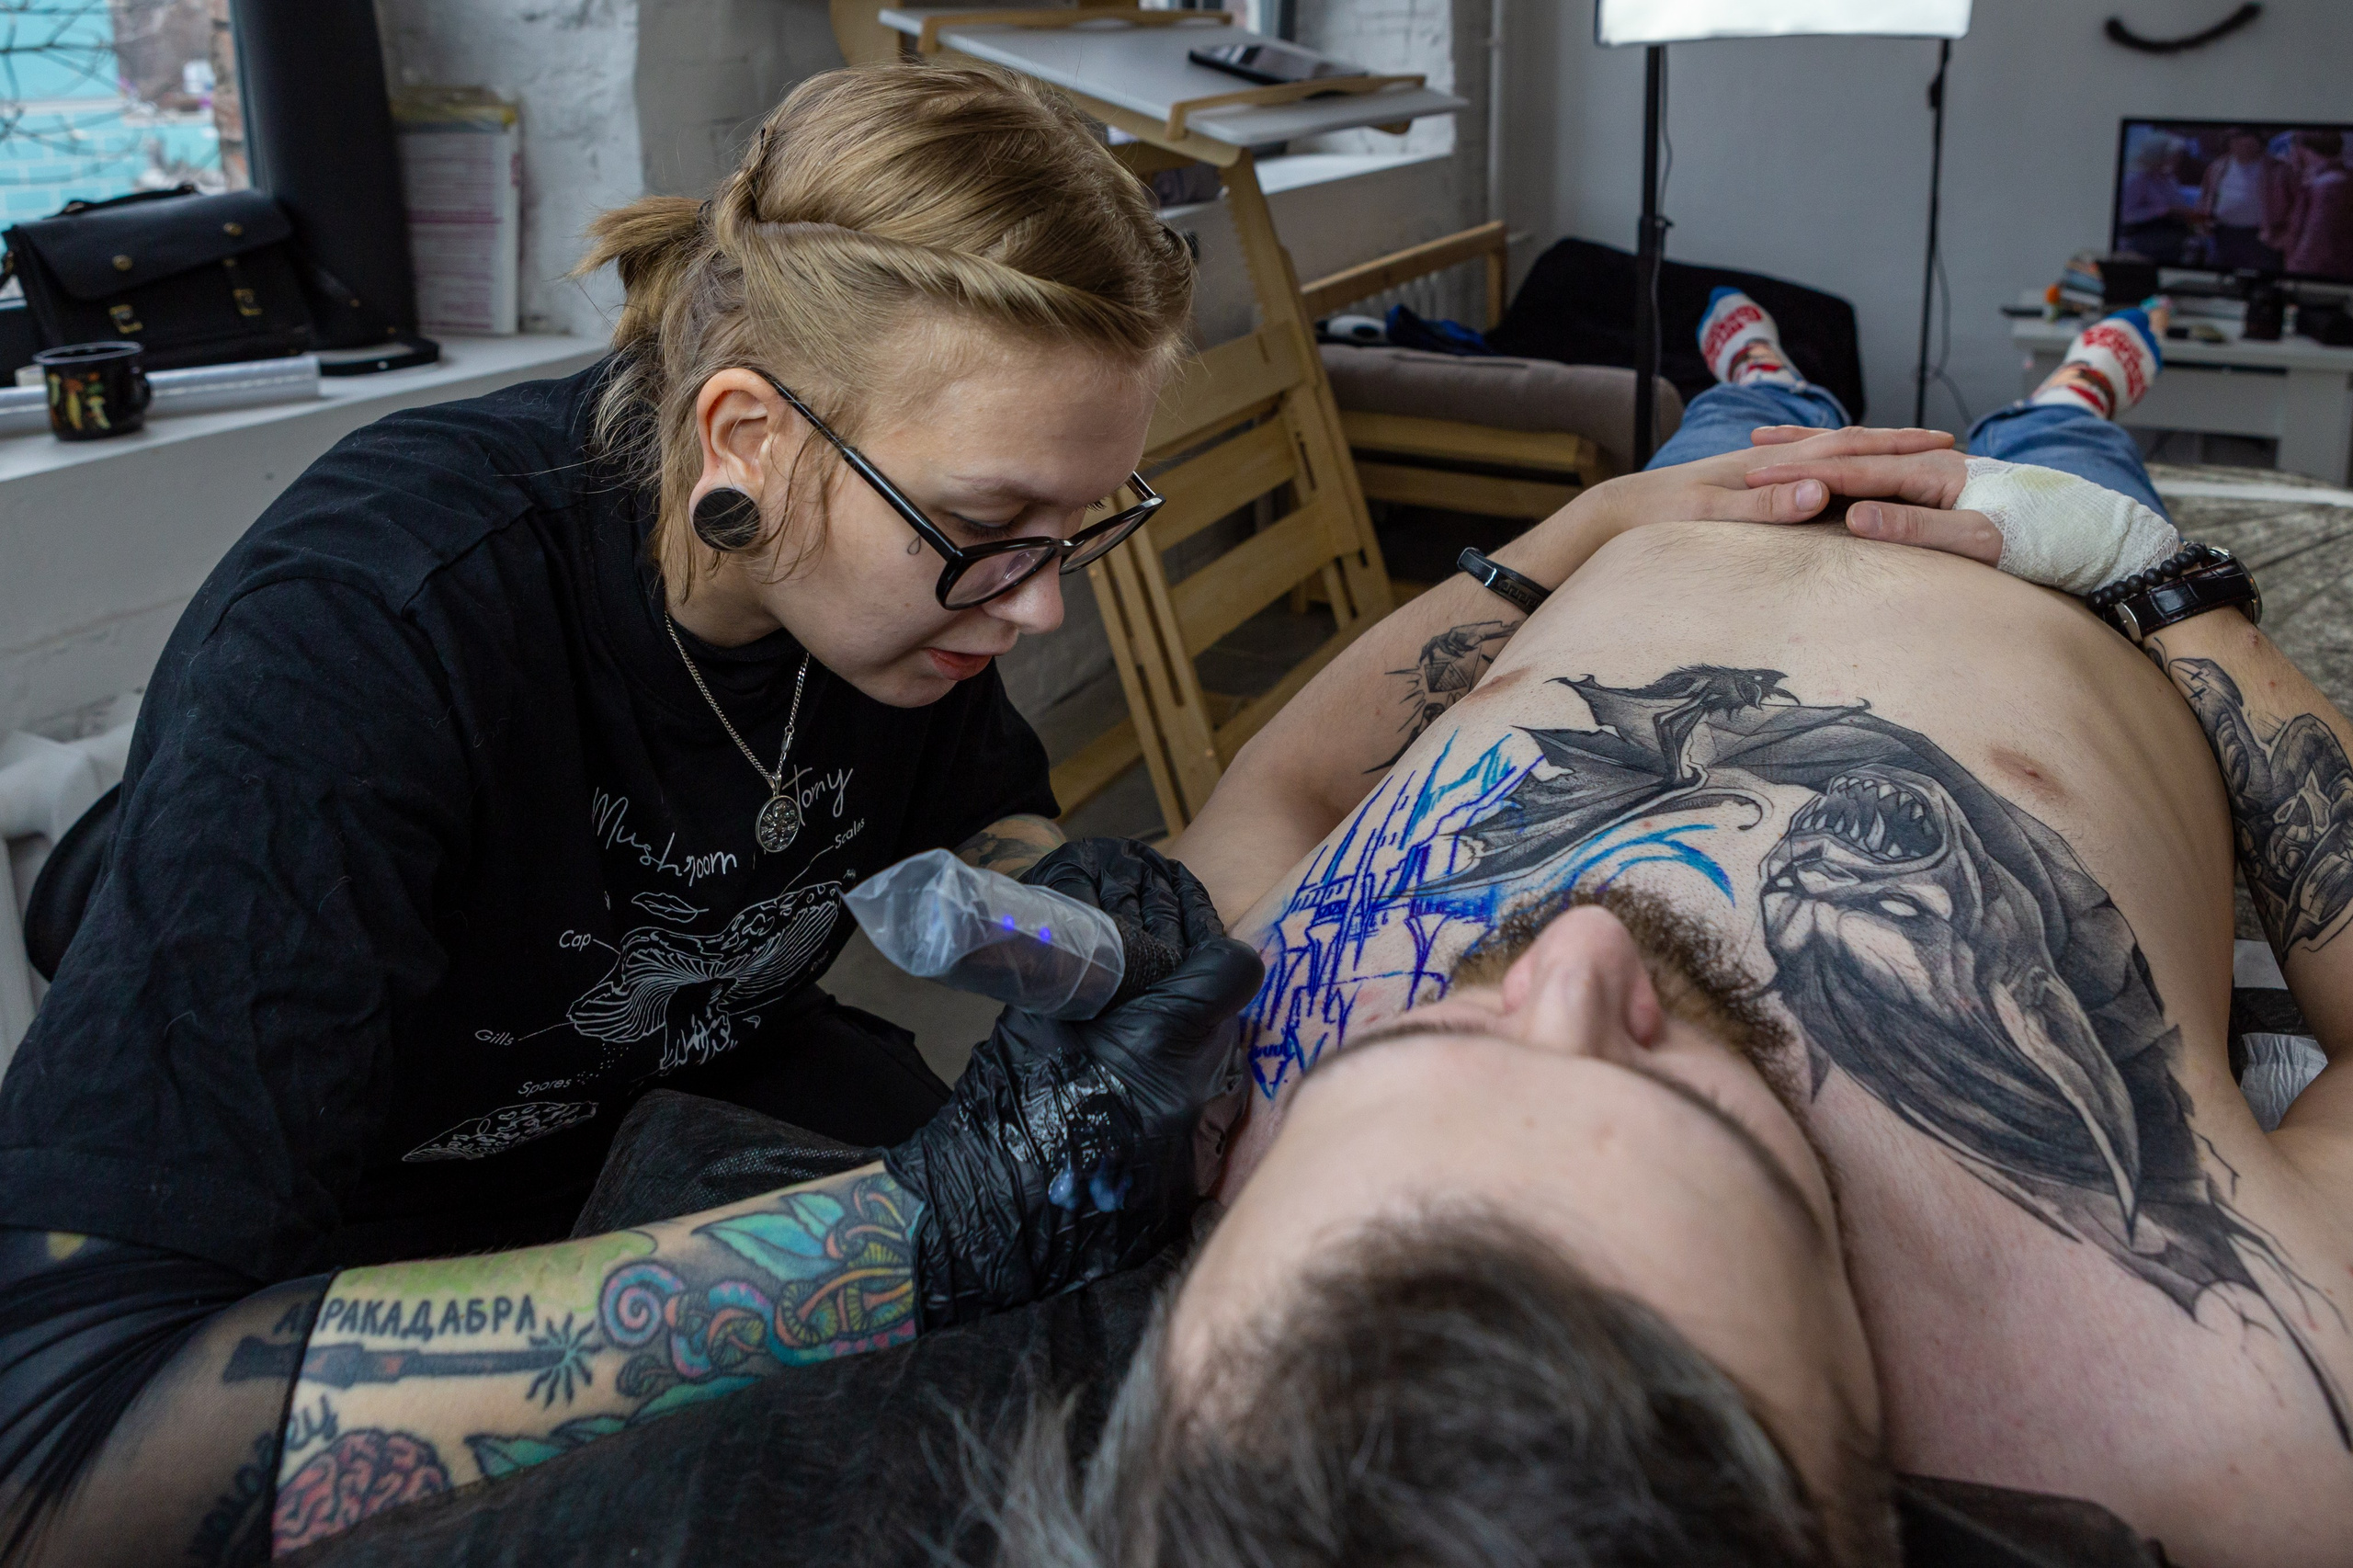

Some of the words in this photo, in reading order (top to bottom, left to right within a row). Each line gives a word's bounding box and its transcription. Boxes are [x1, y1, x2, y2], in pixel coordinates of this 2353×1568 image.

[592, 787, 737, 887] Mushroom
[835, 818, 866, 850] Scales
[559, 929, 591, 951] Cap
[474, 1029, 515, 1046] Gills
[517, 1078, 573, 1097] Spores
[273, 1294, 537, 1342] АРАКАДАБРА
